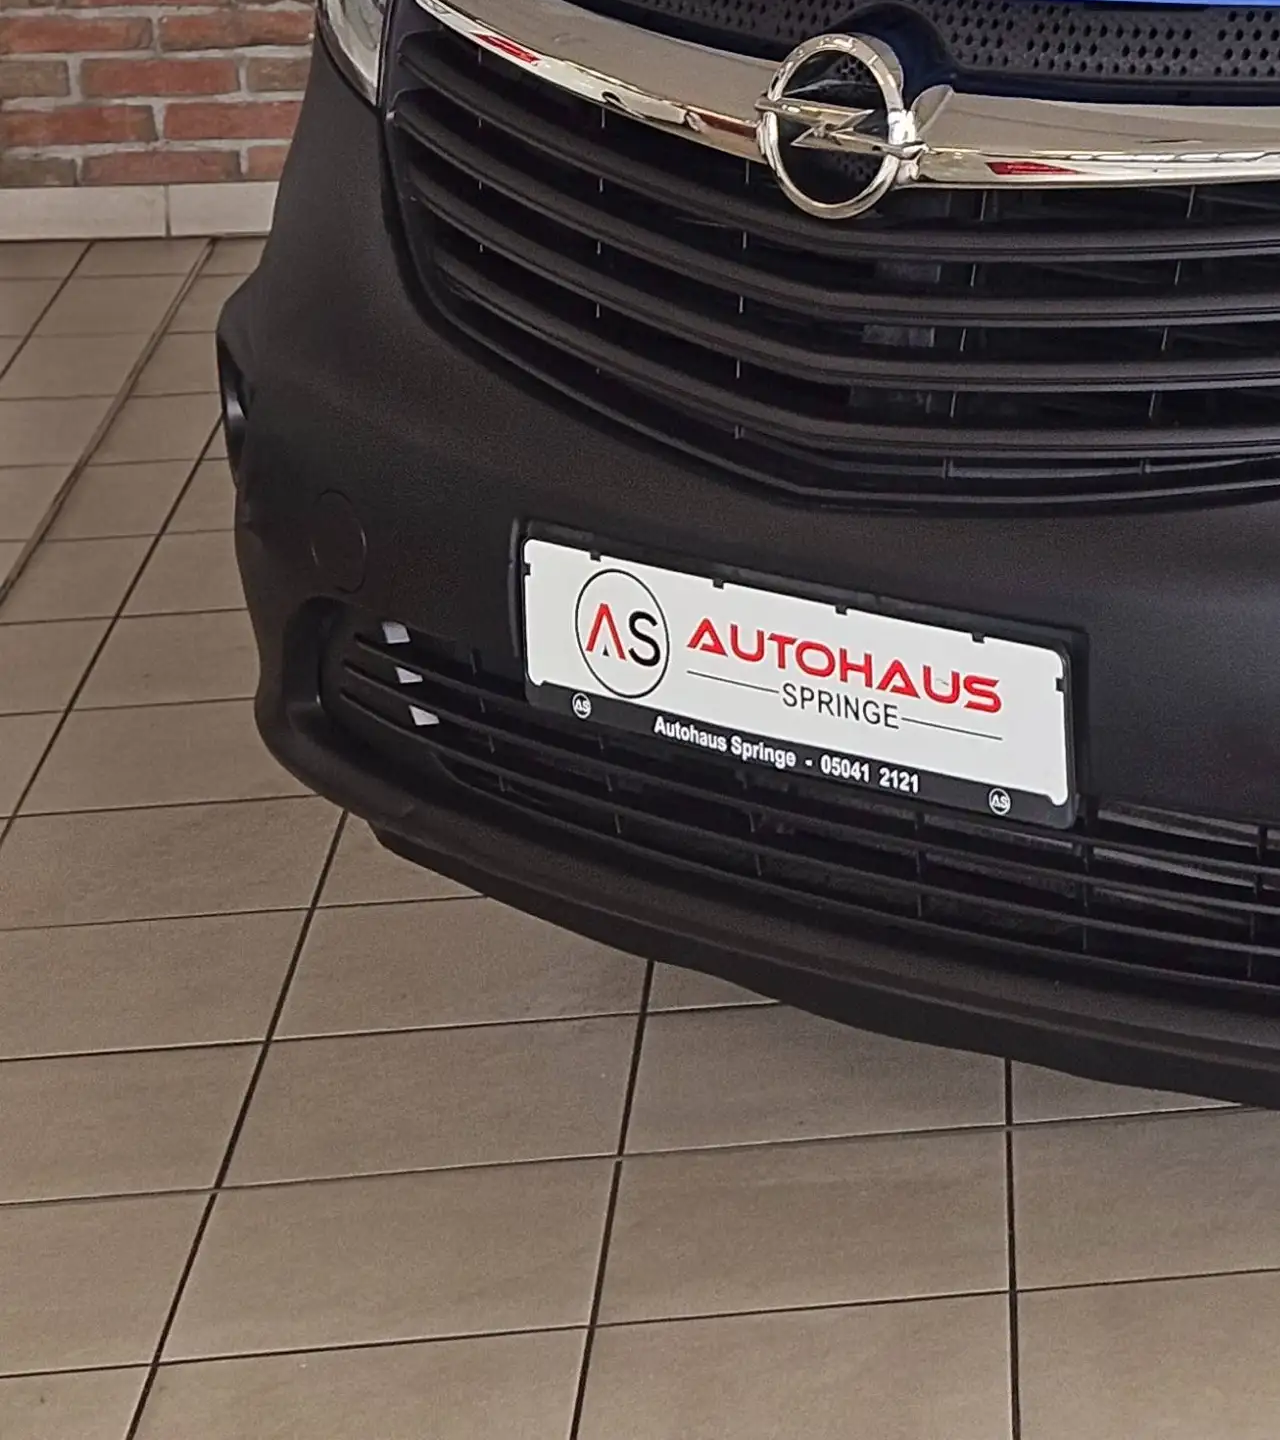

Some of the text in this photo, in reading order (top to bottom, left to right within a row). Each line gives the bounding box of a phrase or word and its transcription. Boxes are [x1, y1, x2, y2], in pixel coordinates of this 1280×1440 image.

[585, 603, 661, 668] AS
[686, 617, 1003, 715] AUTOHAUS
[782, 682, 900, 730] SPRINGE
[653, 716, 728, 754] Autohaus
[730, 735, 797, 770] Springe
[820, 755, 870, 784] 05041
[878, 767, 920, 794] 2121
